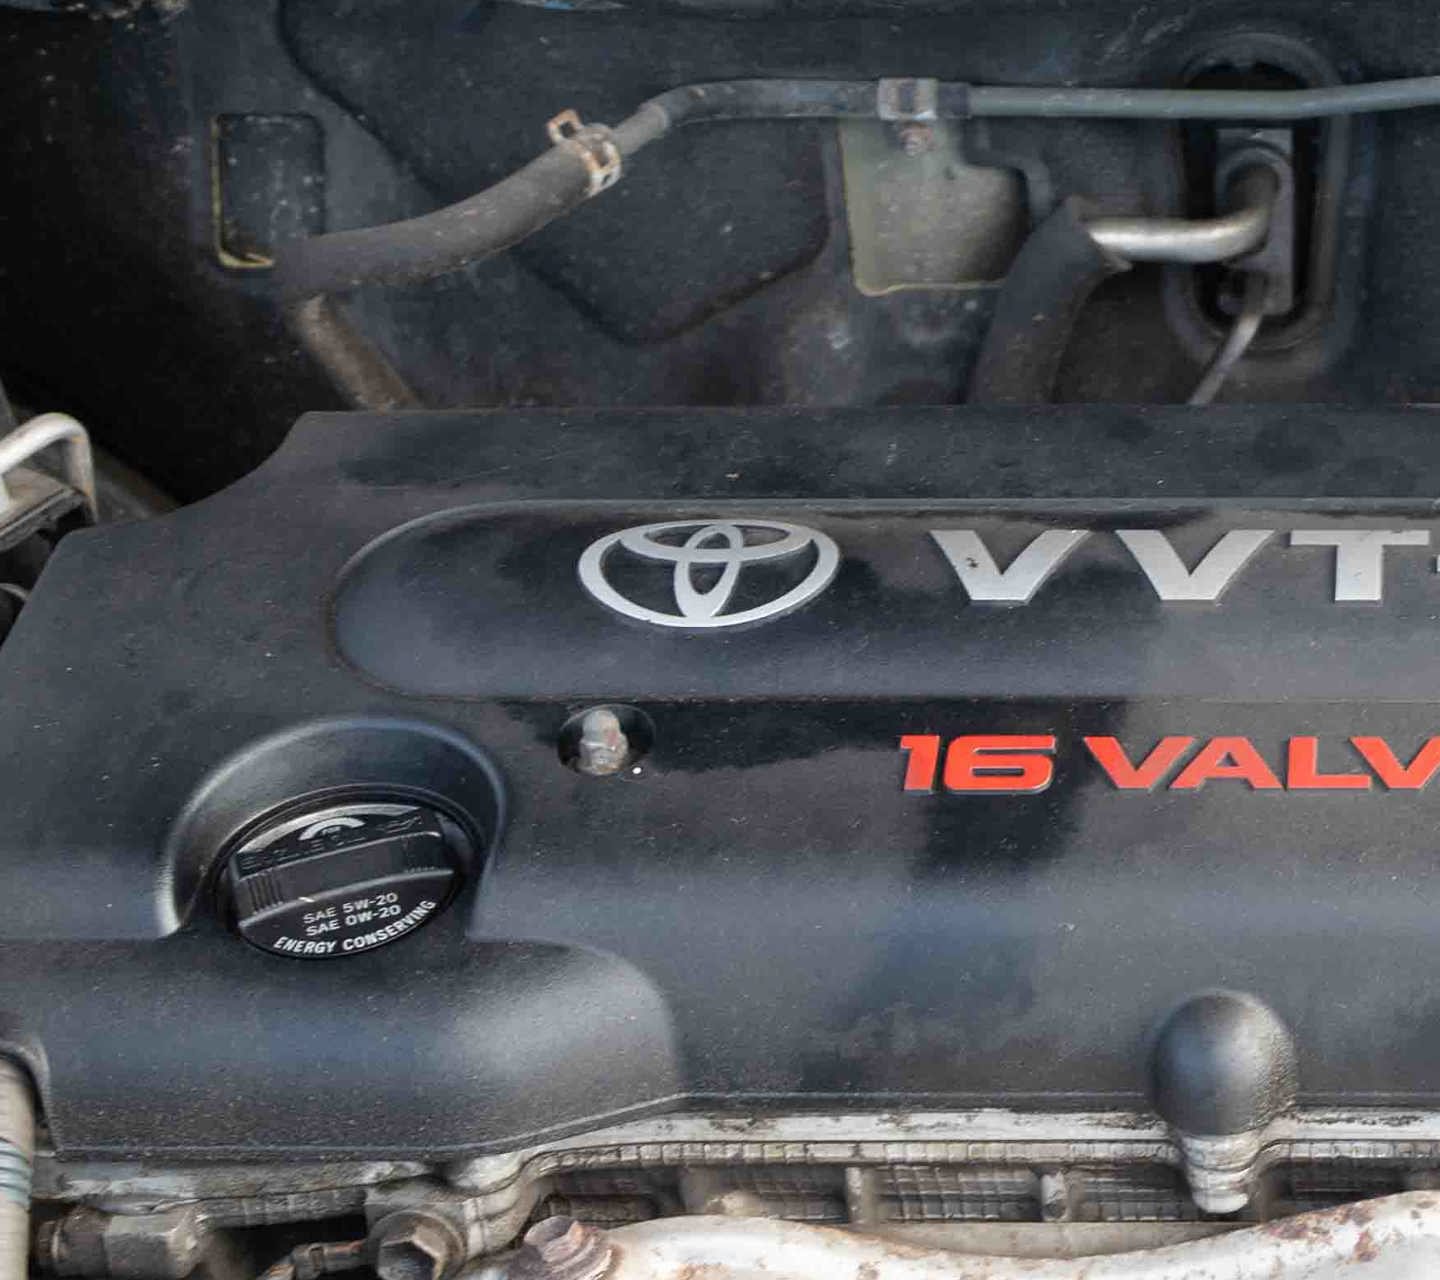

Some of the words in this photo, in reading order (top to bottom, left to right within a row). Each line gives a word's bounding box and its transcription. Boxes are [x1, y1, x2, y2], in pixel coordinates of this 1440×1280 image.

[897, 733, 1057, 792] 16
[272, 935, 338, 955] ENERGY
[342, 899, 438, 951] CONSERVING
[303, 906, 337, 924] SAE
[342, 892, 399, 914] 5W-20
[306, 918, 342, 937] SAE
